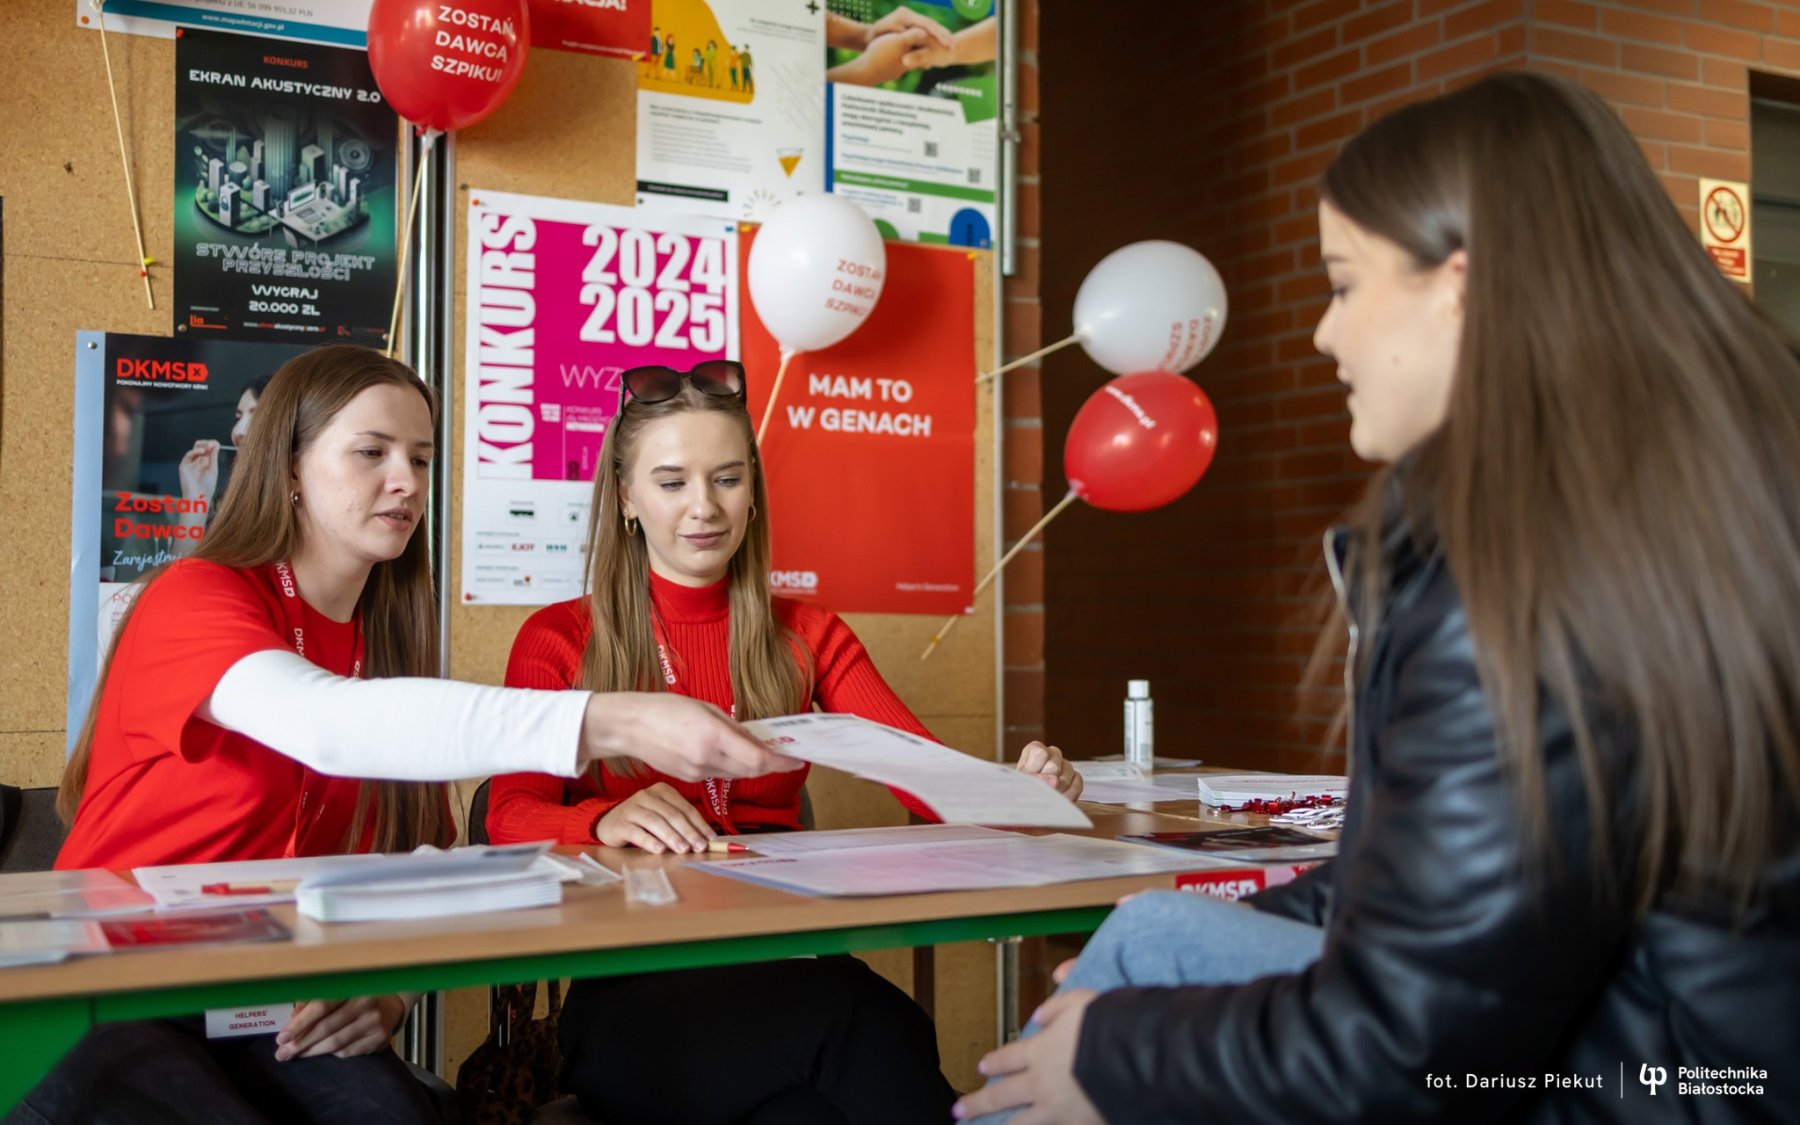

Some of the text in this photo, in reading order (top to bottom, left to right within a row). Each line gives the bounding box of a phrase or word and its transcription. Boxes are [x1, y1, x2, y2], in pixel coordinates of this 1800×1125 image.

[298, 8, 314, 17] PLN
[438, 5, 514, 35] ZOSTAŃ
[263, 55, 309, 69] KONKURS
[430, 55, 503, 83] SZPIKU!
[189, 69, 381, 103] EKRAN AKUSTYCZNY 2.0
[291, 250, 376, 271] PROJEKT
[582, 224, 728, 297] 2024
[251, 284, 319, 300] WYGRAJ
[248, 300, 299, 315] 20.000
[579, 281, 728, 354] 2025
[477, 212, 537, 480] KONKURS
[116, 357, 187, 382] DKMS
[559, 364, 624, 392] WYZ
[808, 373, 913, 404] MAM TO
[786, 405, 932, 437] W GENACH
[114, 491, 208, 514] Zostań
[228, 1020, 276, 1031] GENERATION
